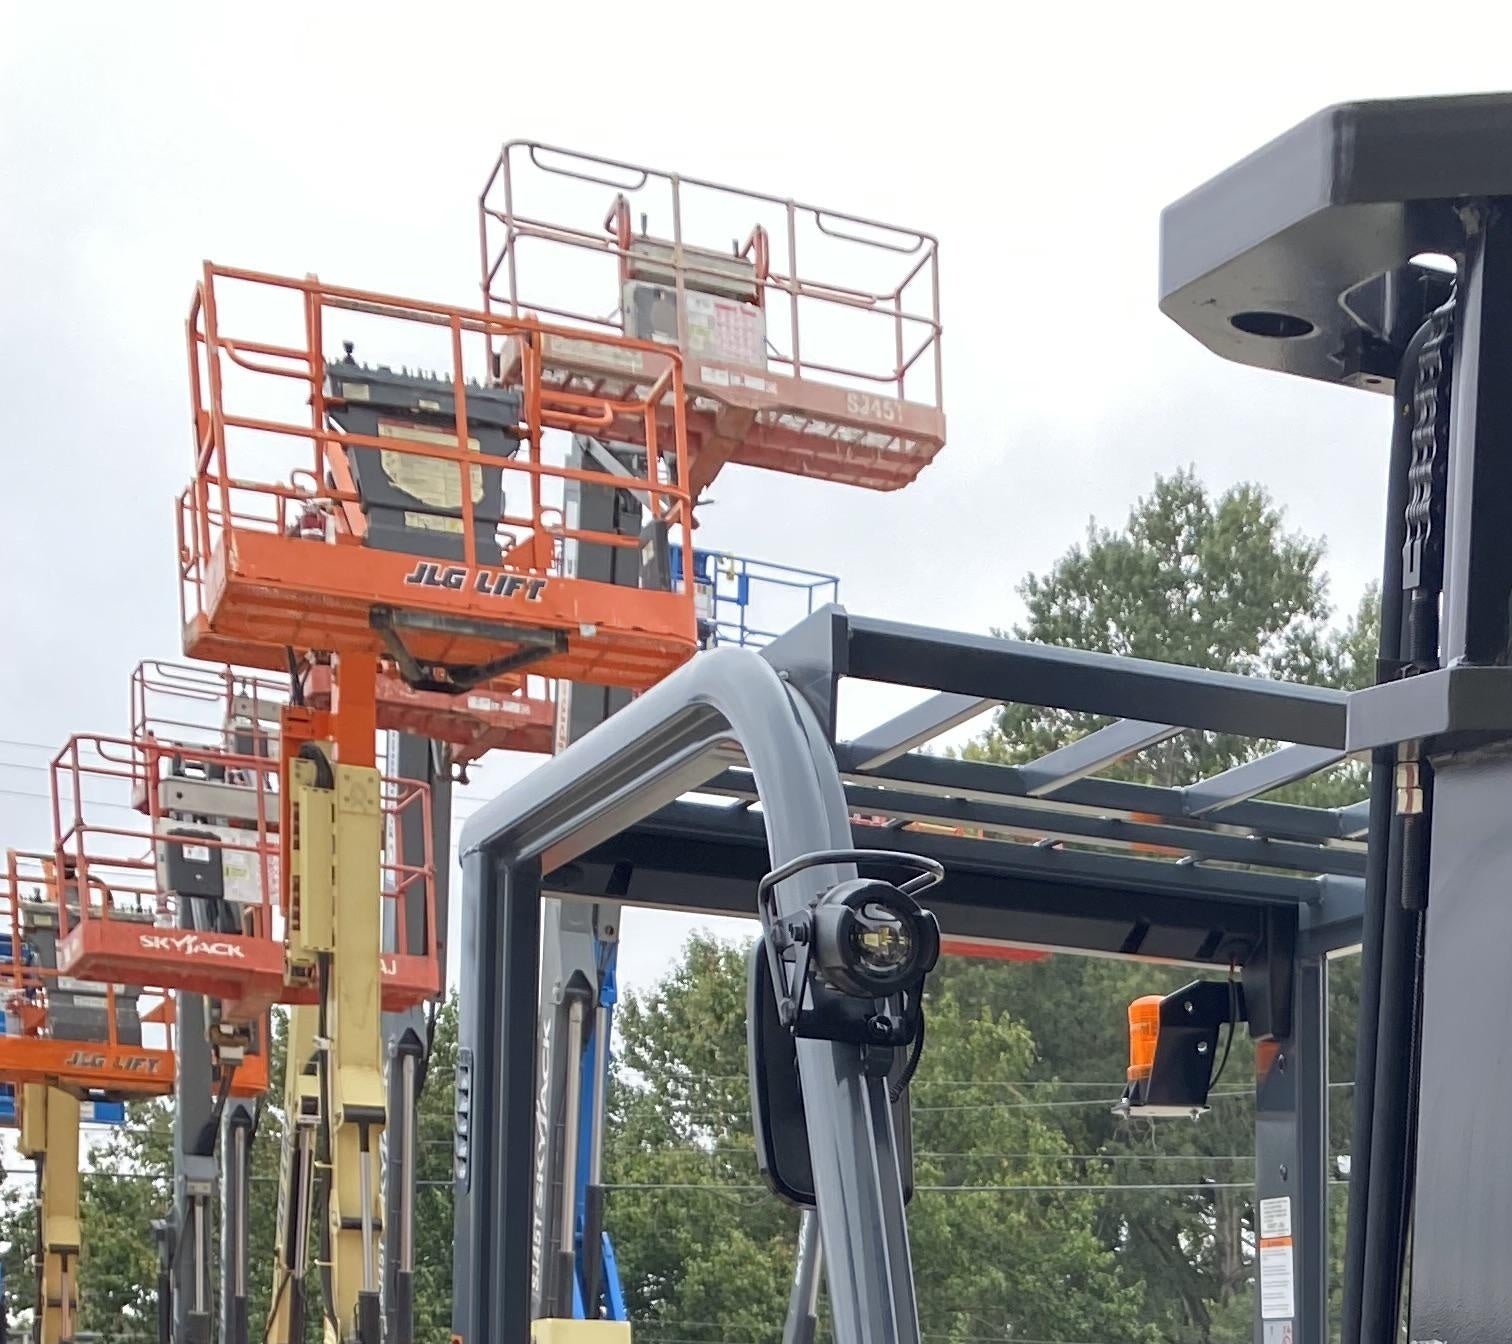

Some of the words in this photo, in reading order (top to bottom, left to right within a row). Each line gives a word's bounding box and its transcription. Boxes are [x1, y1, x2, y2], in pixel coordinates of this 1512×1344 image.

[404, 560, 469, 592] JLG
[475, 569, 549, 602] LIFT
[139, 934, 244, 958] SKYJACK
[66, 1050, 106, 1068] JLG
[112, 1056, 160, 1074] LIFT
